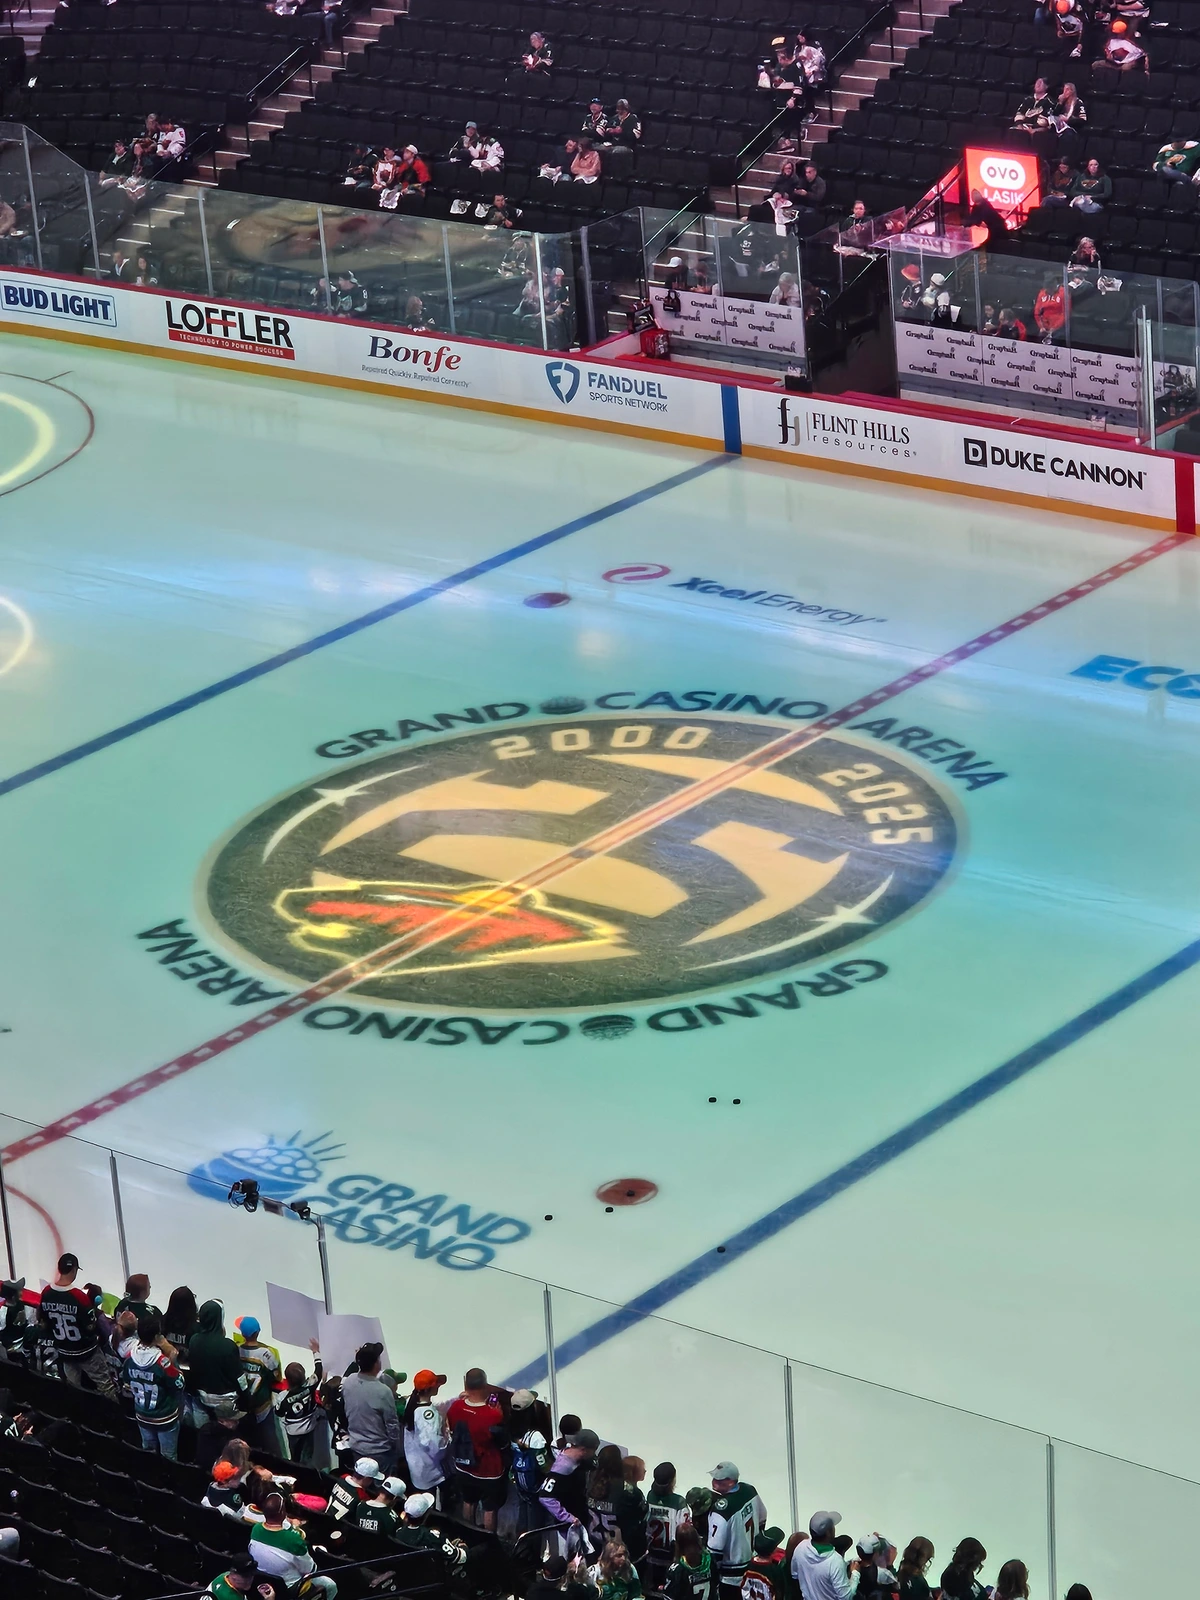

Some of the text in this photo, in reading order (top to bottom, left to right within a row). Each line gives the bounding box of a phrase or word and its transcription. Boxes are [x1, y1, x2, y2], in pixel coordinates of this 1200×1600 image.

[987, 166, 1019, 181] OVO
[3, 284, 112, 321] BUD LIGHT
[165, 301, 294, 348] LOFFLER
[179, 333, 220, 345] TECHNOLOGY
[231, 341, 253, 351] POWER
[255, 346, 284, 356] SUCCESS
[368, 335, 462, 373] Bonfe
[361, 364, 388, 376] Repaired
[413, 372, 440, 384] Repaired
[587, 371, 668, 400] FANDUEL
[589, 391, 669, 413] SPORTS NETWORK
[811, 412, 911, 445] FLINT HILLS
[812, 433, 912, 458] resources
[990, 446, 1145, 490] DUKE CANNON
[315, 690, 1008, 792] GRAND CASINO ARENA
[489, 724, 711, 760] 2000
[818, 763, 934, 846] 2025
[136, 918, 888, 1046] GRAND CASINO ARENA
[327, 1174, 531, 1244] GRAND
[284, 1196, 496, 1271] CASINO
[48, 1312, 82, 1342] 36
[359, 1518, 379, 1531] FABER
[712, 1524, 718, 1538] 7
